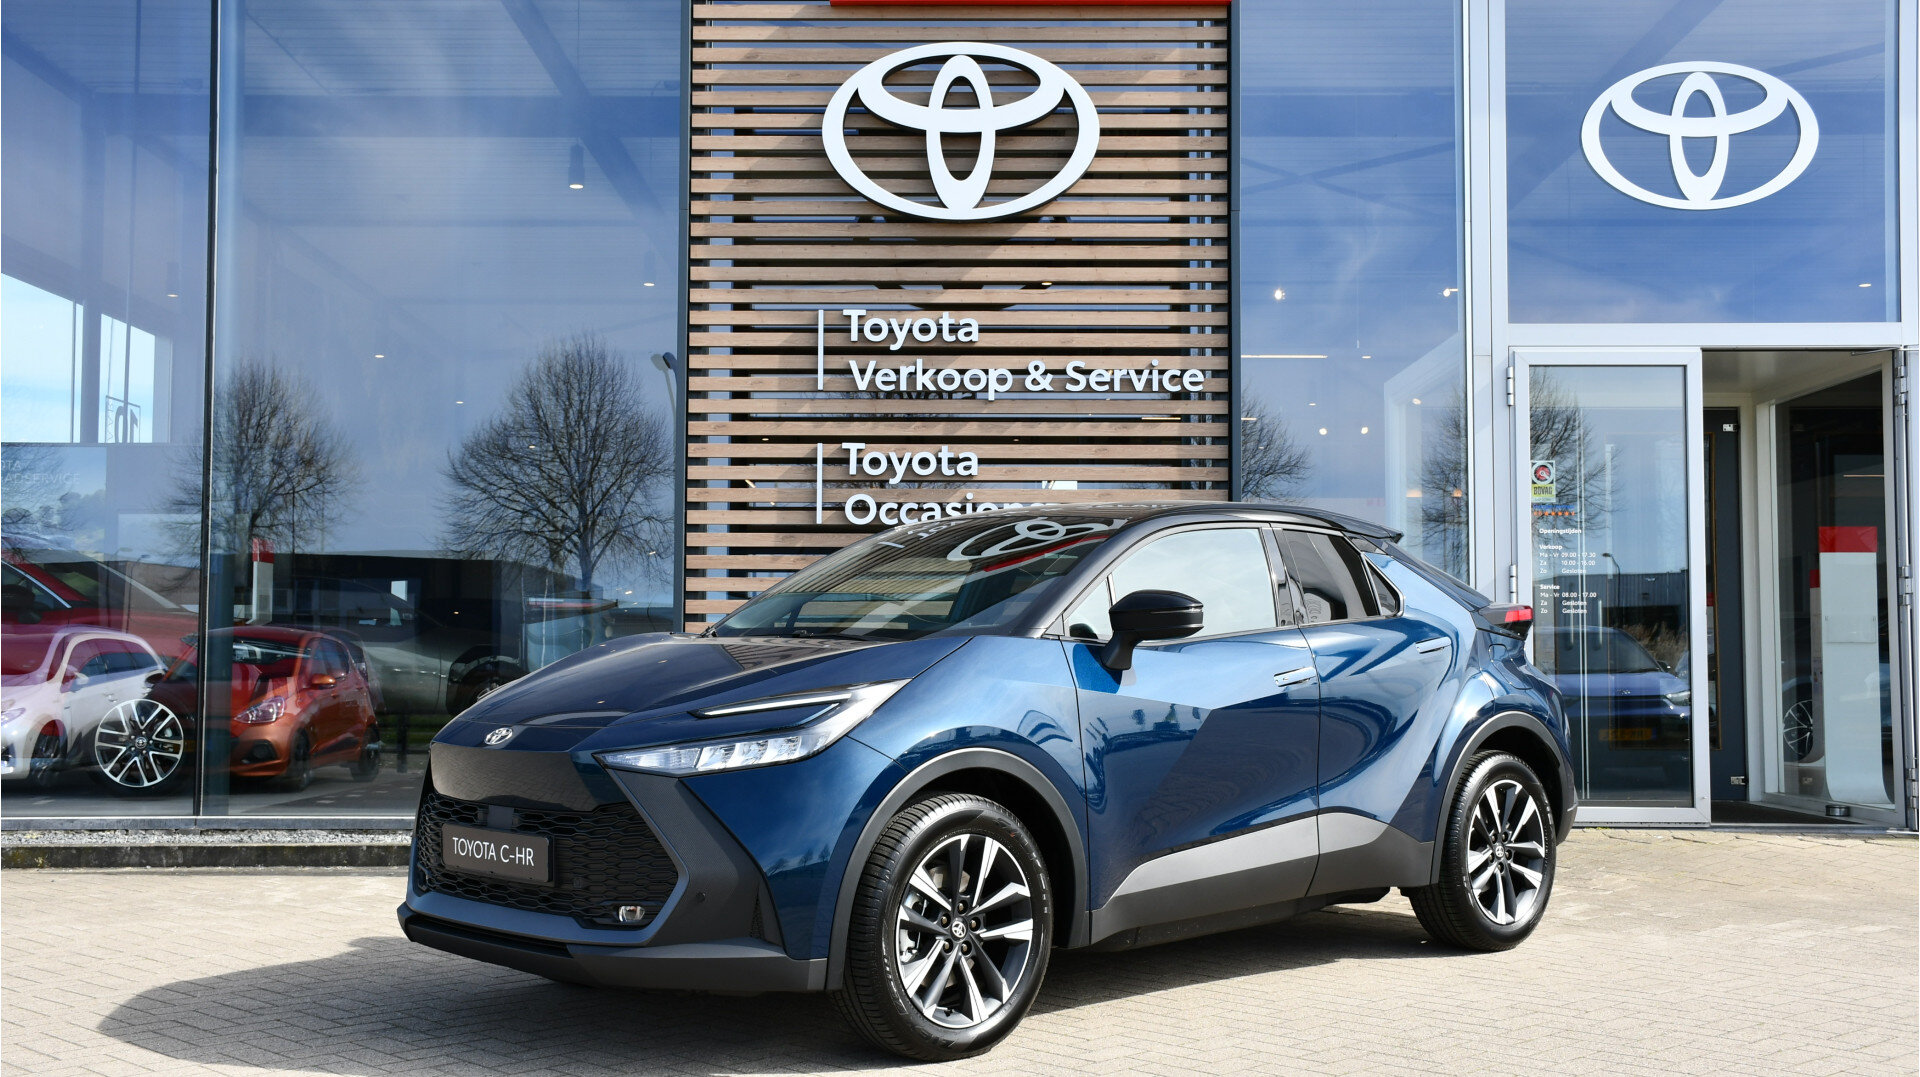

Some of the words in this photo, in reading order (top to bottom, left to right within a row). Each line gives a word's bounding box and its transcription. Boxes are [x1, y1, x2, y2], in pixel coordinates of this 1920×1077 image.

[843, 309, 979, 350] Toyota
[849, 359, 1013, 400] Verkoop
[1024, 360, 1053, 392] &
[1065, 359, 1204, 392] Service
[842, 442, 979, 484] Toyota
[844, 492, 1048, 525] Occasi
[452, 837, 497, 861] TOYOTA
[500, 844, 535, 867] C-HR
